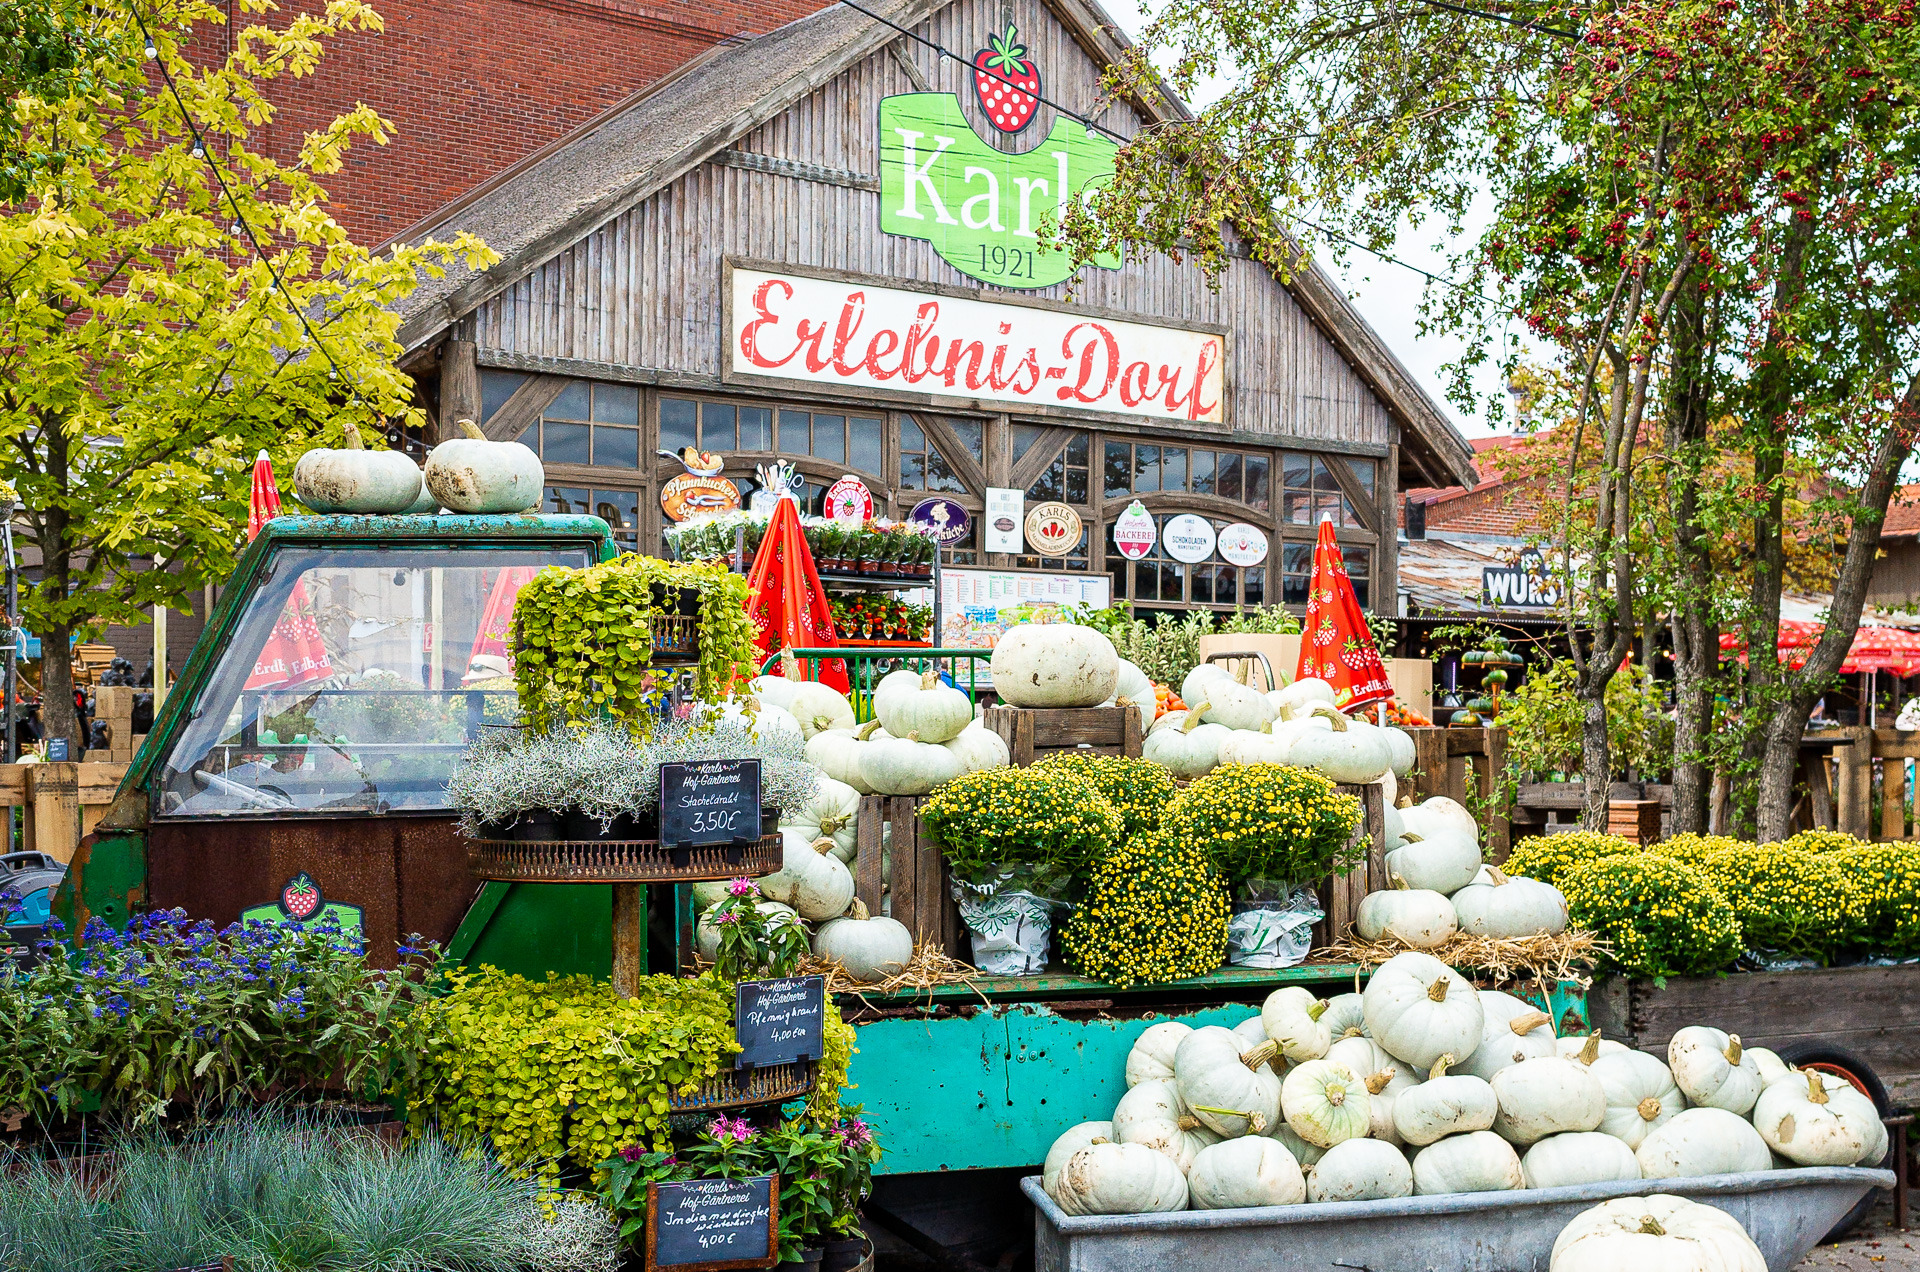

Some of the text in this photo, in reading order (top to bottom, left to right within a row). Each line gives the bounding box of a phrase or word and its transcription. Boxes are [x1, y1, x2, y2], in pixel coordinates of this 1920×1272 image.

[979, 244, 1036, 280] 1921
[740, 279, 1218, 421] Erlebnis-Dorf
[1039, 507, 1071, 520] KARLS
[1172, 536, 1208, 545] SCHOKOLADEN
[700, 762, 723, 774] Karls
[682, 773, 741, 791] Hof-Gärtnerei
[690, 810, 741, 833] 3,50€
[773, 980, 792, 993] Karls
[702, 1181, 729, 1194] Karls
[680, 1192, 750, 1212] Hof-Gärtnerei
